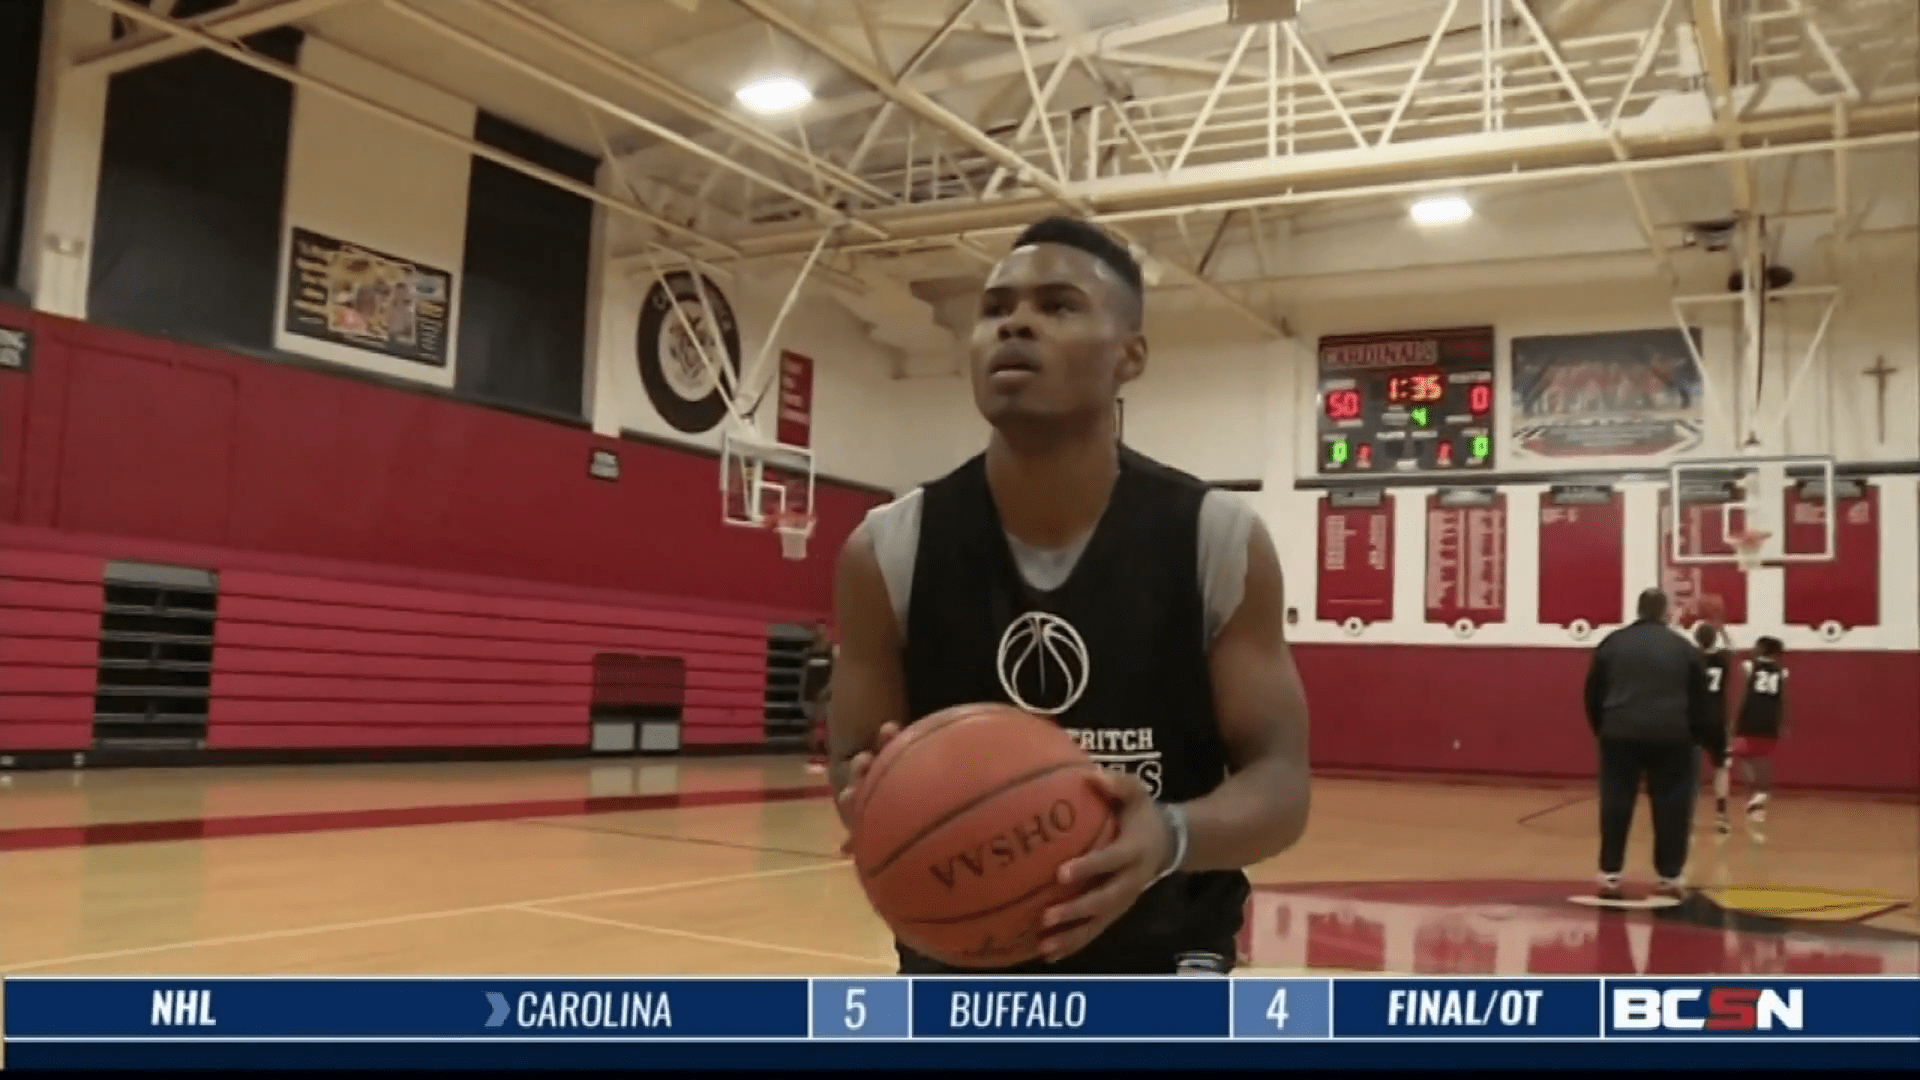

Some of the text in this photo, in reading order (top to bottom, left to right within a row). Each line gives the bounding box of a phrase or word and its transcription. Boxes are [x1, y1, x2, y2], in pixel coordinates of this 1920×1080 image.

[1388, 373, 1443, 401] 1:35
[1471, 385, 1490, 412] 0
[1328, 390, 1360, 418] 50
